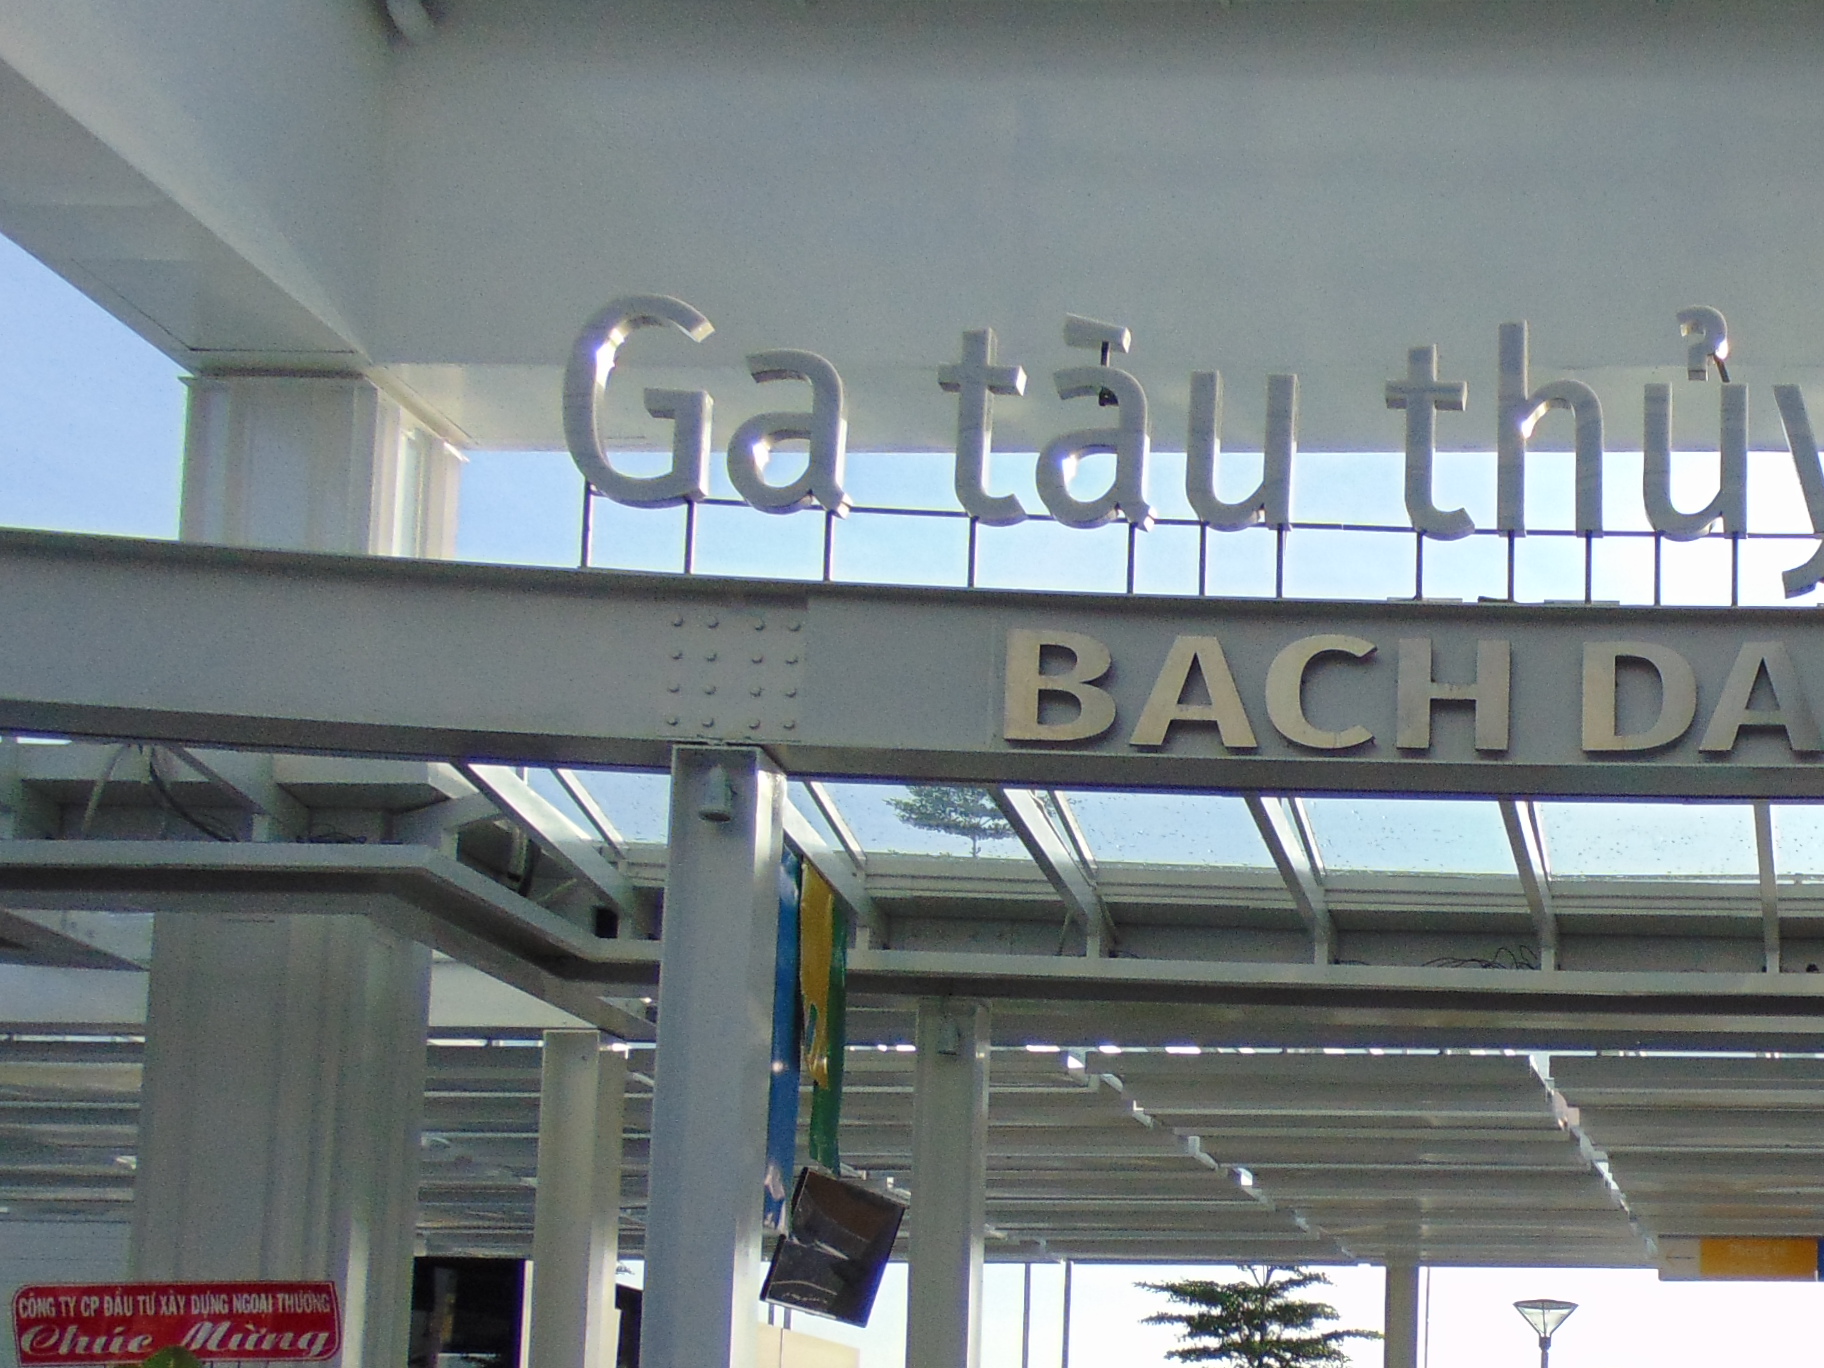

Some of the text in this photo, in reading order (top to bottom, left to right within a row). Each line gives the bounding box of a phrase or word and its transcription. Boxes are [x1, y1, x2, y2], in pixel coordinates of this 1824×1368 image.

[563, 294, 852, 518] Ga
[937, 312, 1300, 531] tàu
[1002, 628, 1512, 754] BACH
[21, 1321, 330, 1358] Chúc Mừng
[58, 1294, 77, 1317] TY
[80, 1294, 100, 1317] CP
[103, 1288, 134, 1317] ĐẦU
